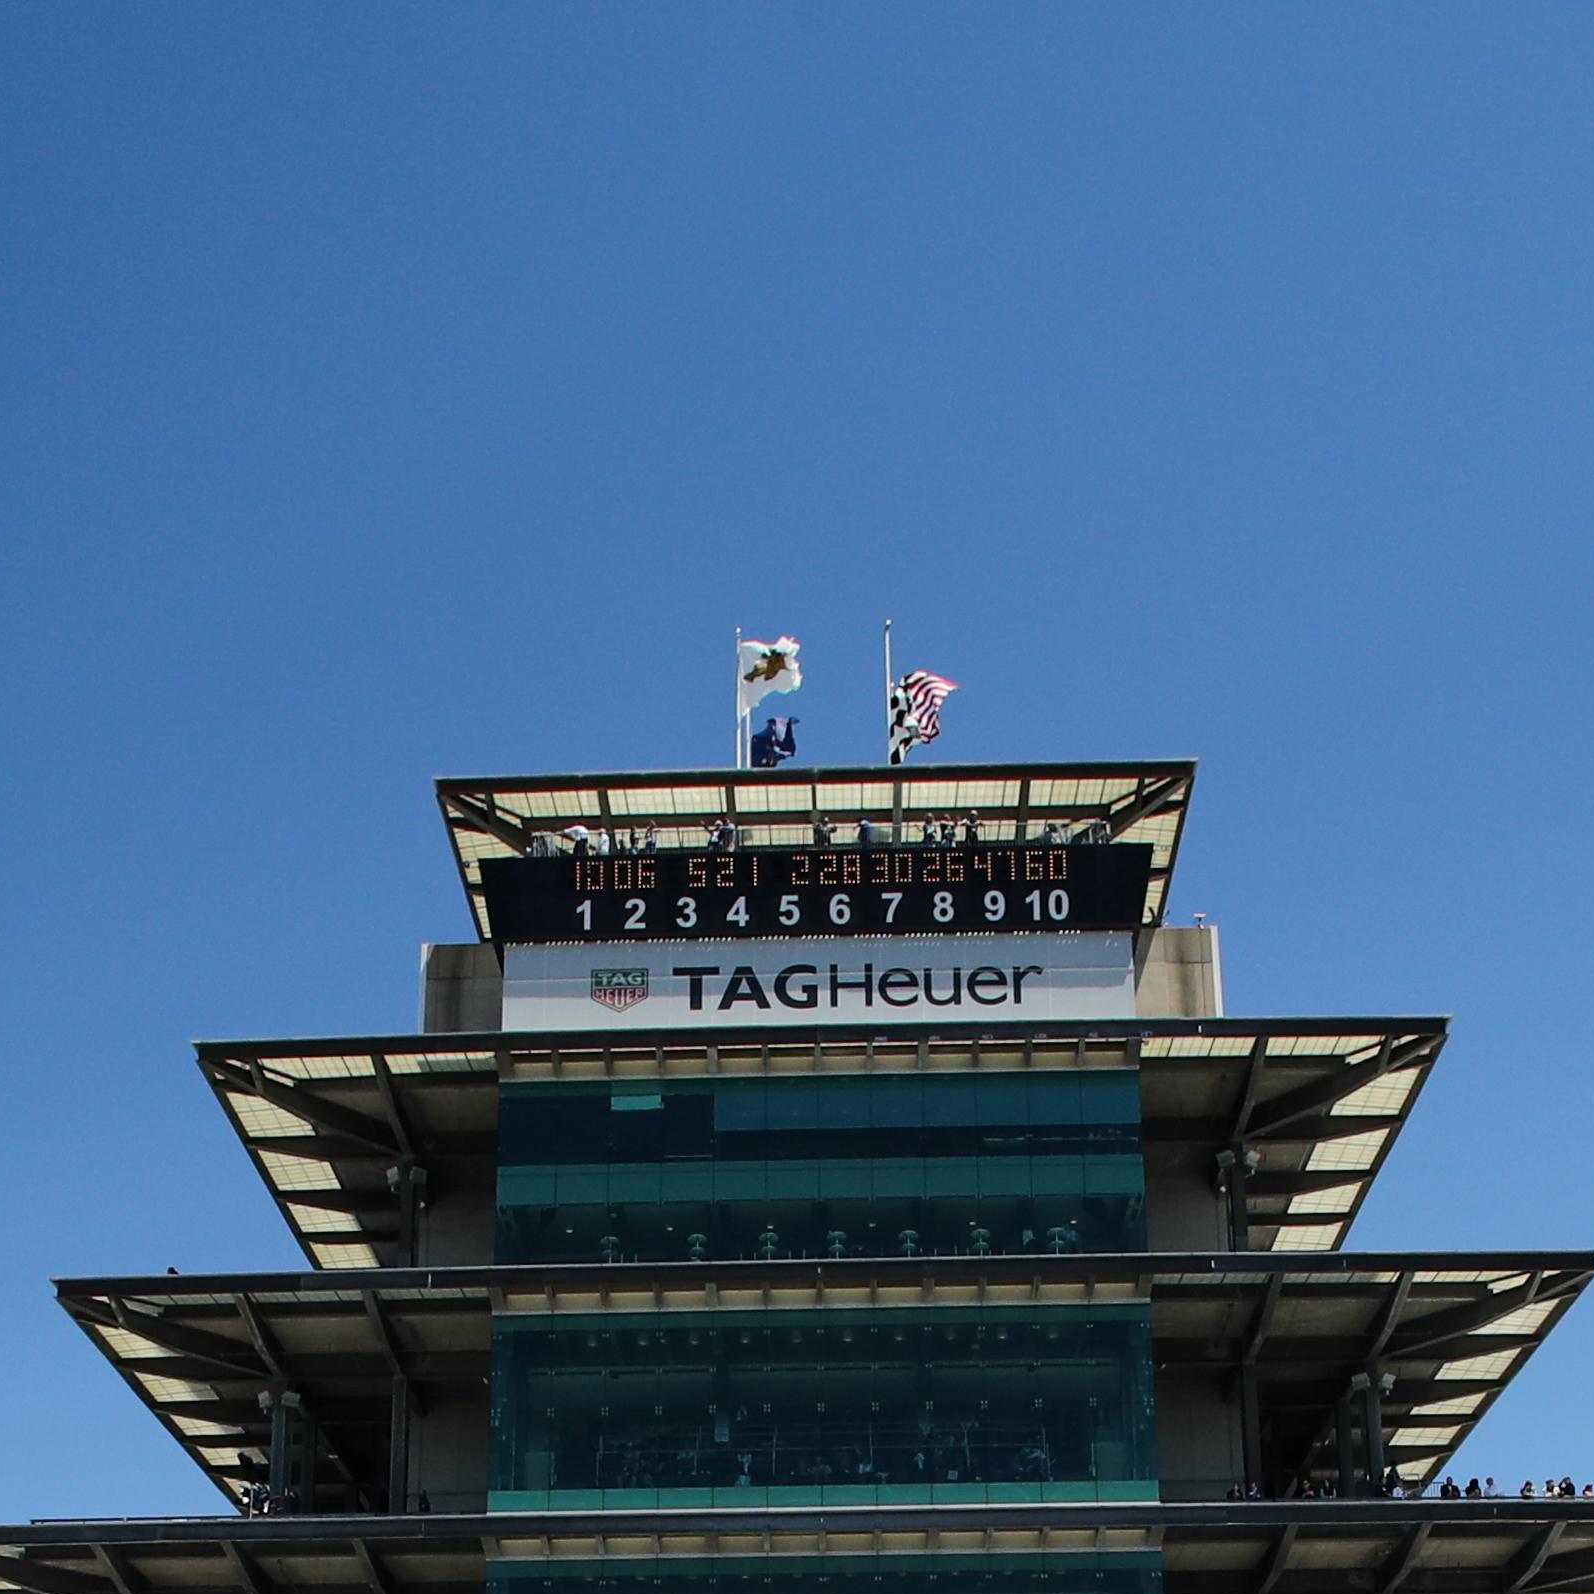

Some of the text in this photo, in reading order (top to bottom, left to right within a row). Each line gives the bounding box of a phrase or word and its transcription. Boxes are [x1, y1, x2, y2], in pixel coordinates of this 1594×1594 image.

[688, 858, 706, 887] 5
[792, 855, 809, 885] 2
[576, 889, 1070, 931] 1 2 3 4 5 6 7 8 9 10
[597, 972, 643, 986] TAG
[595, 987, 644, 1006] HEUER
